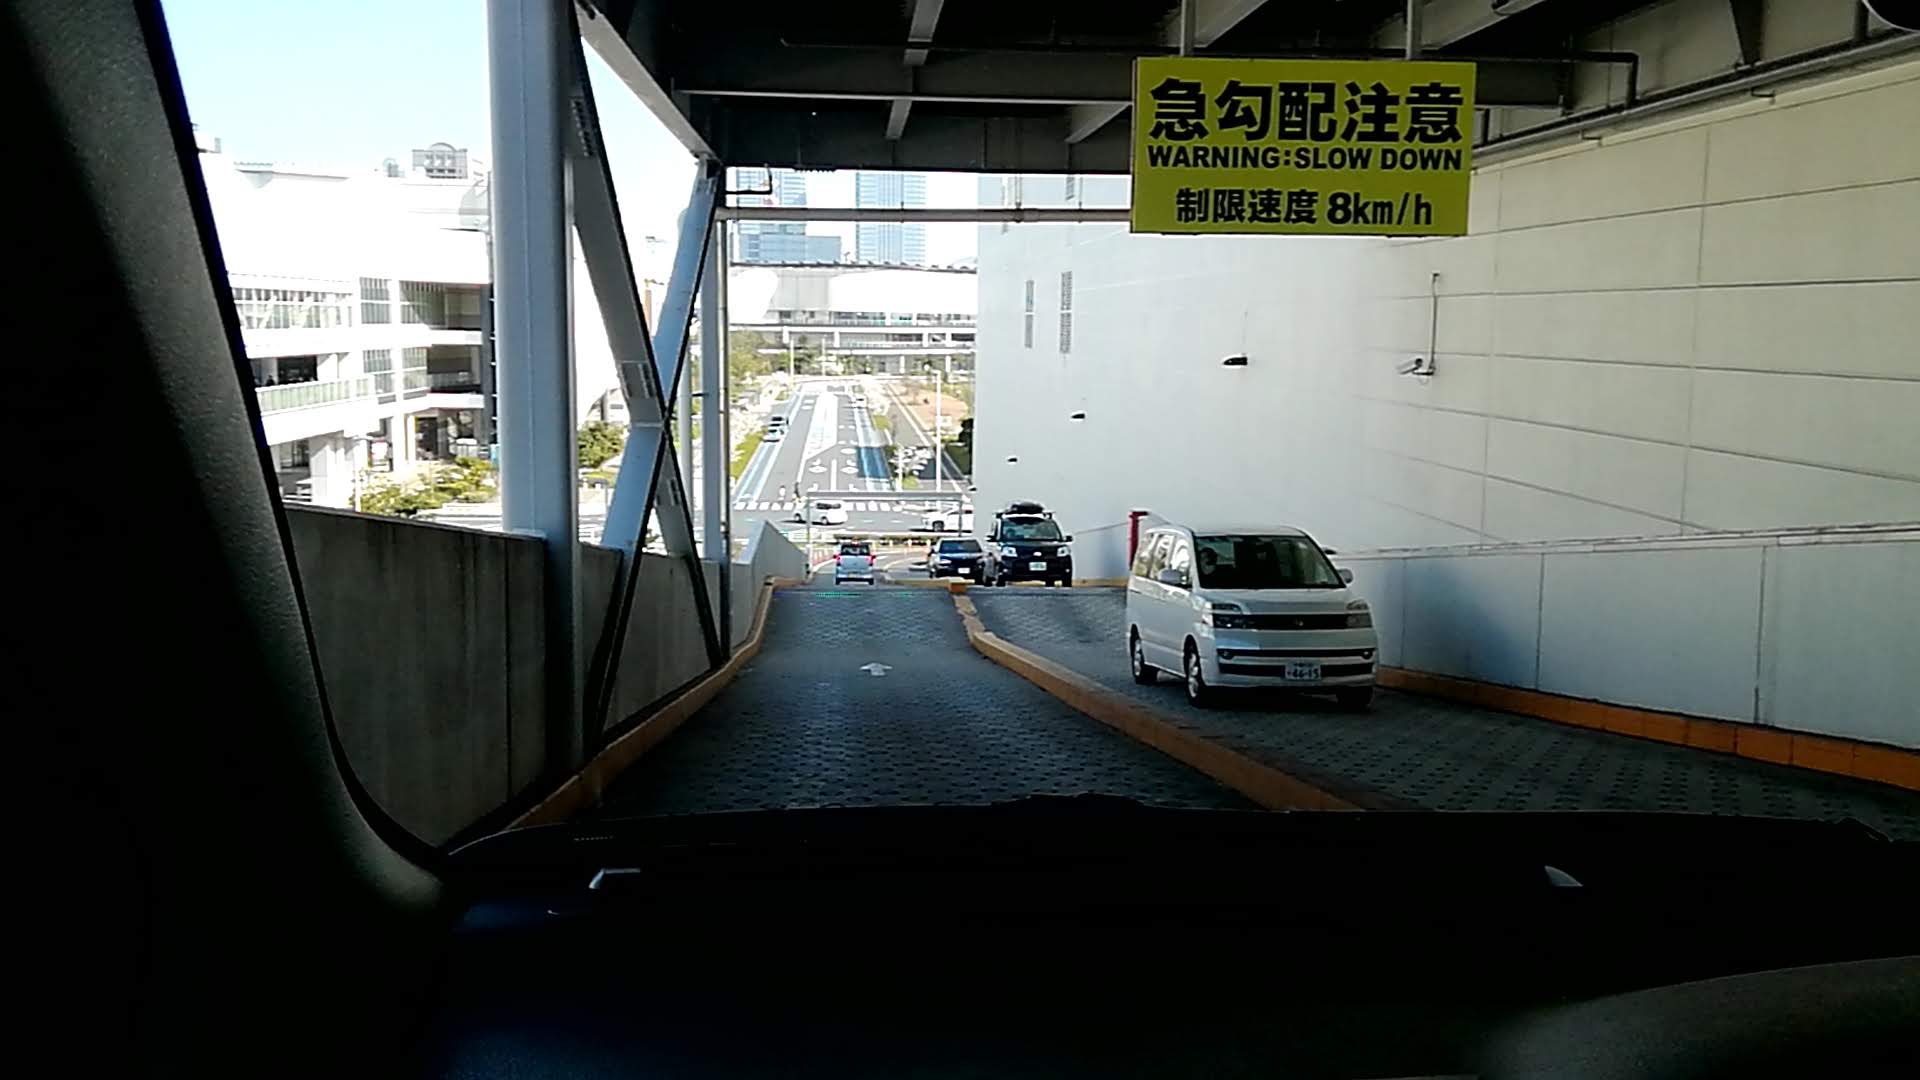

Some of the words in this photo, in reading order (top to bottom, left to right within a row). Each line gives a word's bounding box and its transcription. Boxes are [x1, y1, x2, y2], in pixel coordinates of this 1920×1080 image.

[1149, 77, 1464, 143] 急勾配注意
[1148, 145, 1372, 170] WARNING:SLOW
[1380, 148, 1463, 171] DOWN
[1176, 187, 1319, 225] 制限速度
[1326, 191, 1432, 226] 8km/h
